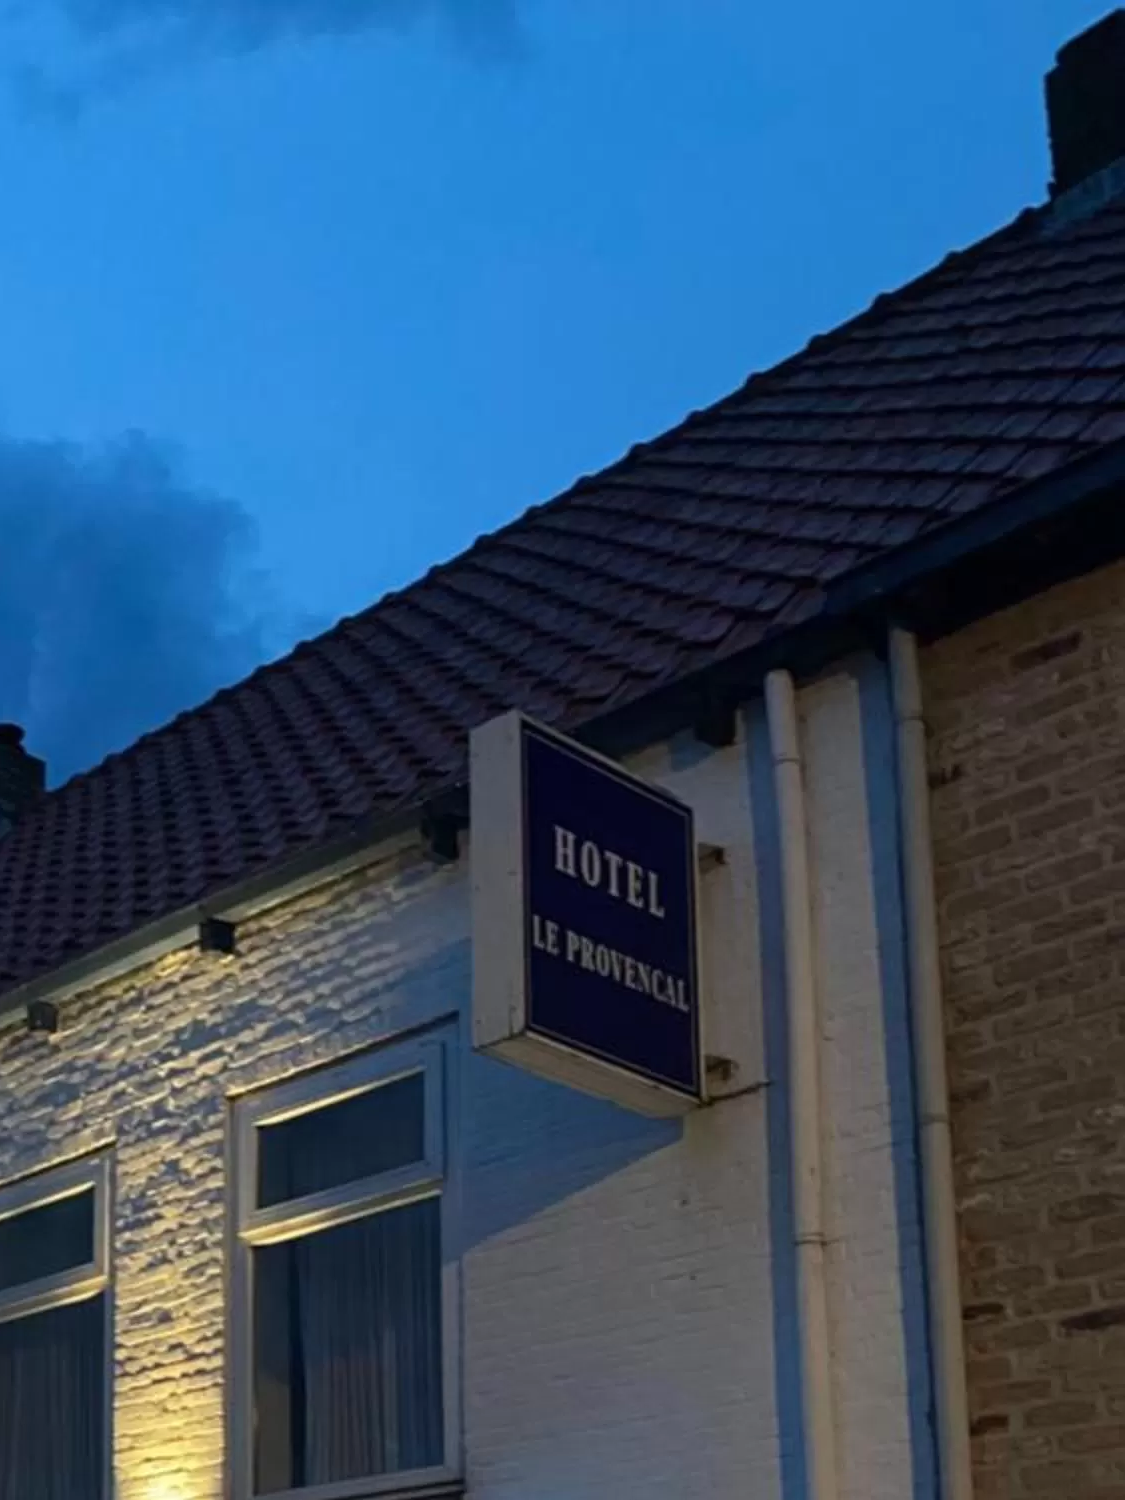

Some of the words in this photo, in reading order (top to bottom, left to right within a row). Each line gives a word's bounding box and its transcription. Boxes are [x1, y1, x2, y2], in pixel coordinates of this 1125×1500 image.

[552, 823, 665, 919] HOTEL
[532, 913, 562, 956] LE
[566, 929, 690, 1013] PROVENCAL
